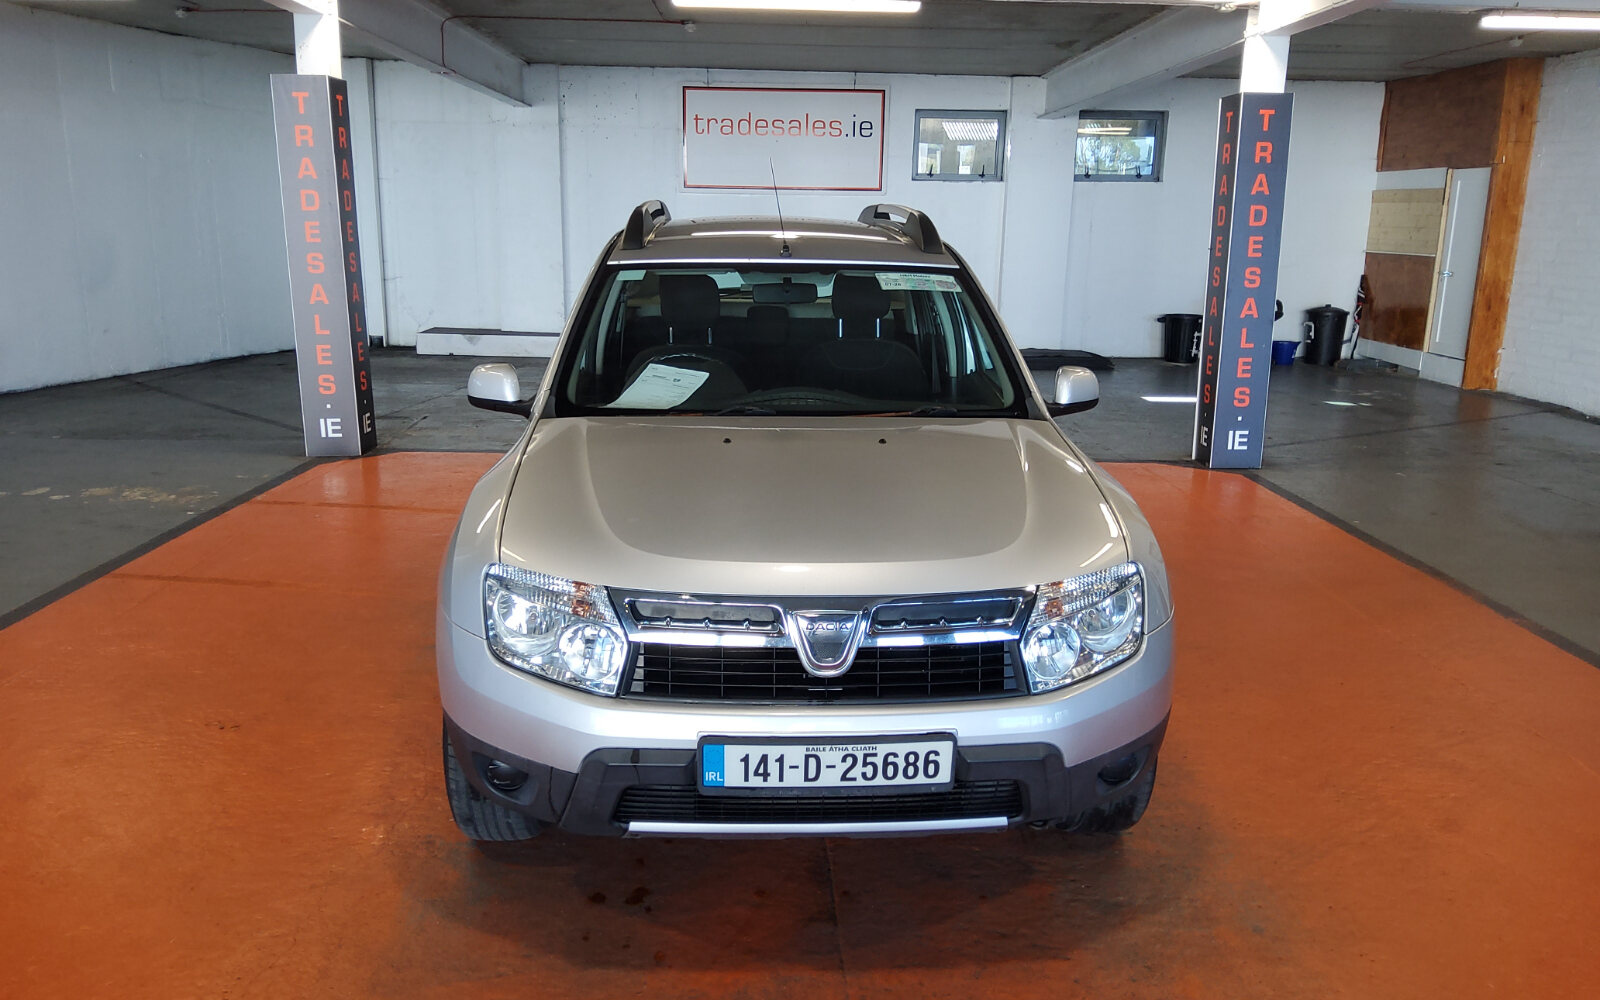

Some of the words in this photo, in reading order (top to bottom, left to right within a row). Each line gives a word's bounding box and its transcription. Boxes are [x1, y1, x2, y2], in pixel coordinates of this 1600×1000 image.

[693, 112, 874, 138] tradesales.ie
[805, 622, 850, 631] DACIA
[739, 749, 941, 783] 141-D-25686
[705, 771, 724, 782] IRL
